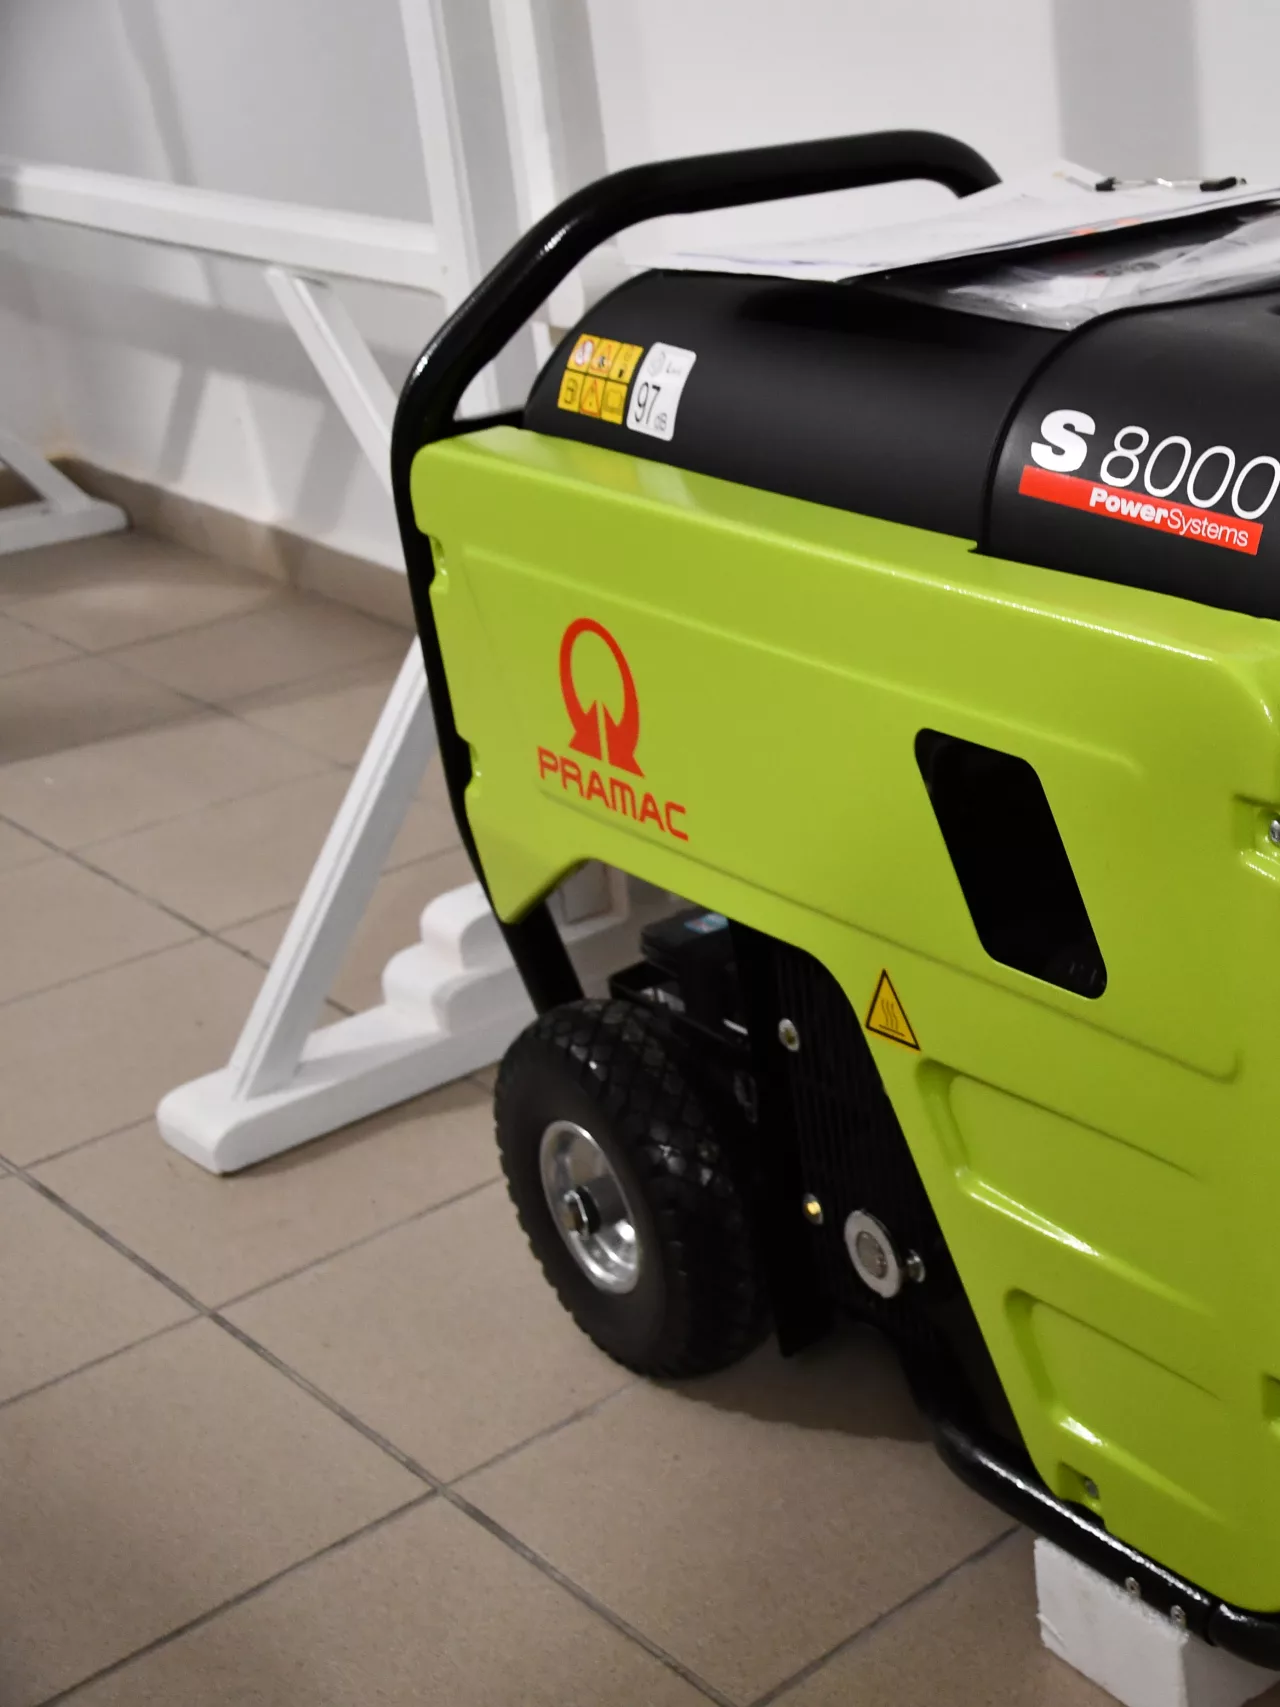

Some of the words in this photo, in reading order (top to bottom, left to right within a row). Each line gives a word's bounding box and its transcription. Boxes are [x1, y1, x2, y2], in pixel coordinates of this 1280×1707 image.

[634, 381, 661, 425] 97
[1030, 408, 1096, 473] S
[1089, 486, 1249, 548] PowerSystems
[537, 745, 689, 842] PRAMAC
